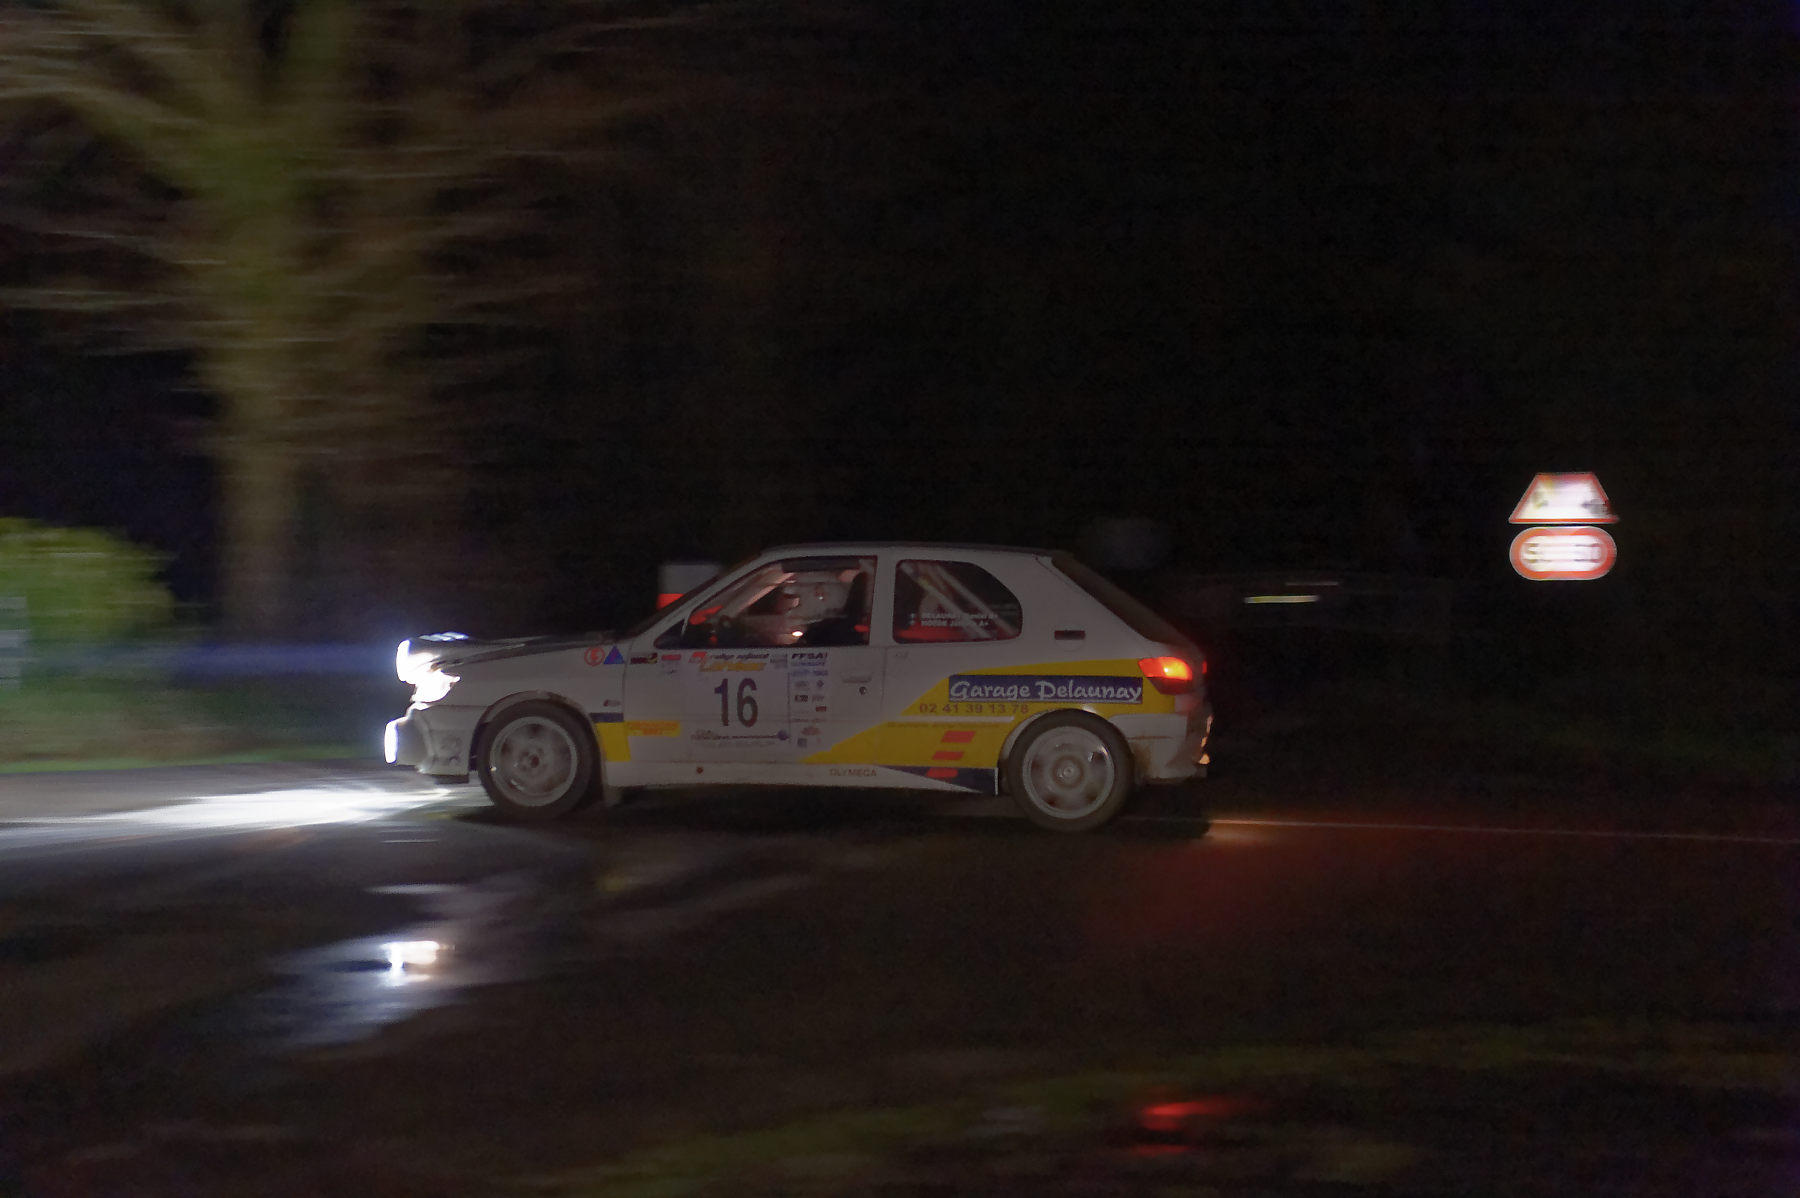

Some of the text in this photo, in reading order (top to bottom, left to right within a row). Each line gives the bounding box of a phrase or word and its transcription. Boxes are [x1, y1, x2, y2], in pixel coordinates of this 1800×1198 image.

[950, 680, 1142, 702] Garage Delaunay
[714, 678, 759, 728] 16
[919, 703, 1030, 714] 02 41 39 13 78
